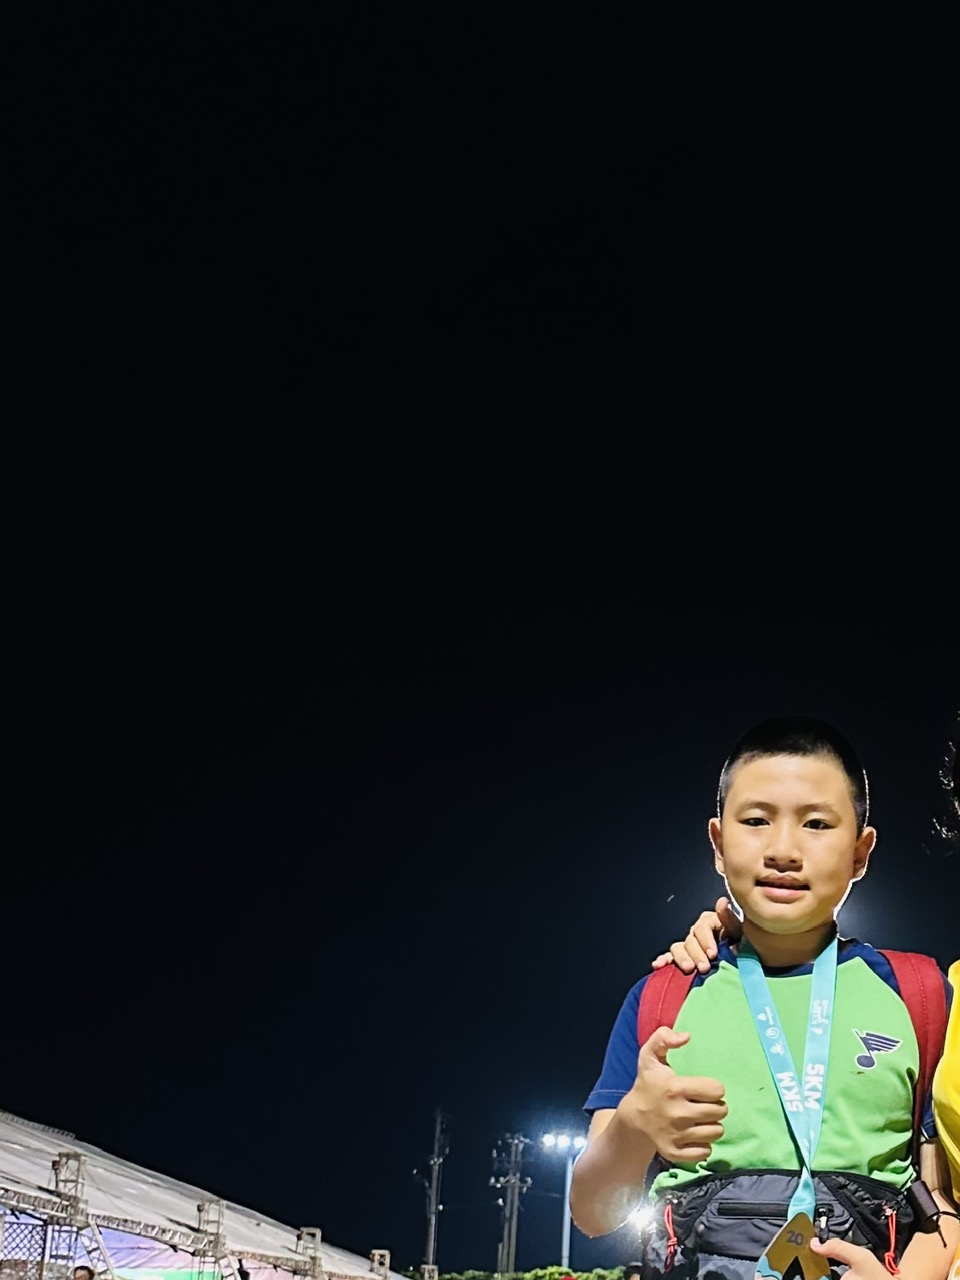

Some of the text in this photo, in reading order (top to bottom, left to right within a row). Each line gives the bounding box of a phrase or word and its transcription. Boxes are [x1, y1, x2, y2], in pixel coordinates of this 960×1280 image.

[775, 1071, 805, 1113] 5KM
[803, 1062, 825, 1110] 5KM
[787, 1230, 804, 1246] 20
